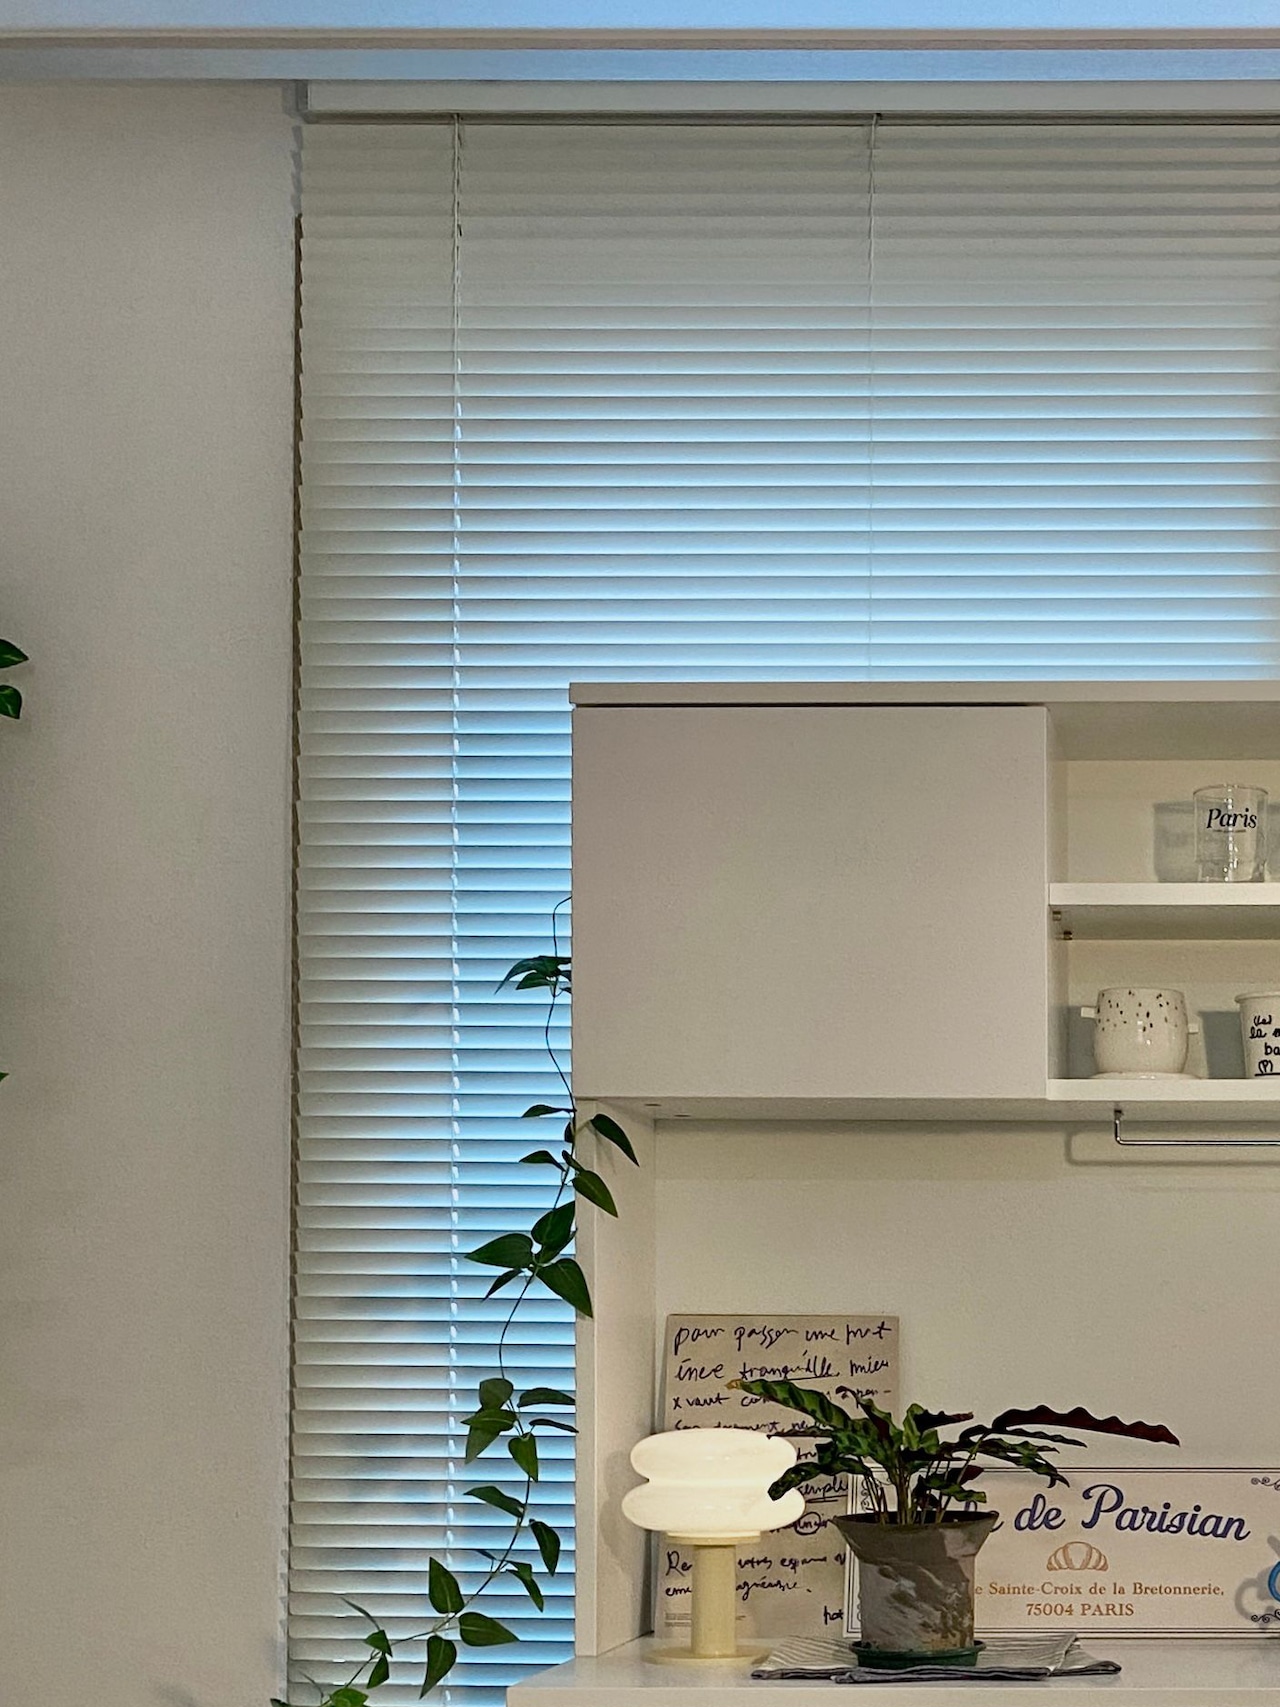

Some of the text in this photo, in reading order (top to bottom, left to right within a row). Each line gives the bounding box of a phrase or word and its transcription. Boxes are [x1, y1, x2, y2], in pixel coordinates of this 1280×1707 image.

[1206, 808, 1257, 829] Paris
[1014, 1493, 1066, 1531] de
[1081, 1484, 1251, 1541] Parisian
[989, 1582, 1082, 1596] Sainte-Croix
[1089, 1582, 1106, 1595] de
[1113, 1582, 1126, 1595] la
[1132, 1582, 1225, 1596] Bretonnerie,
[1026, 1603, 1134, 1616] 75004 PARIS
